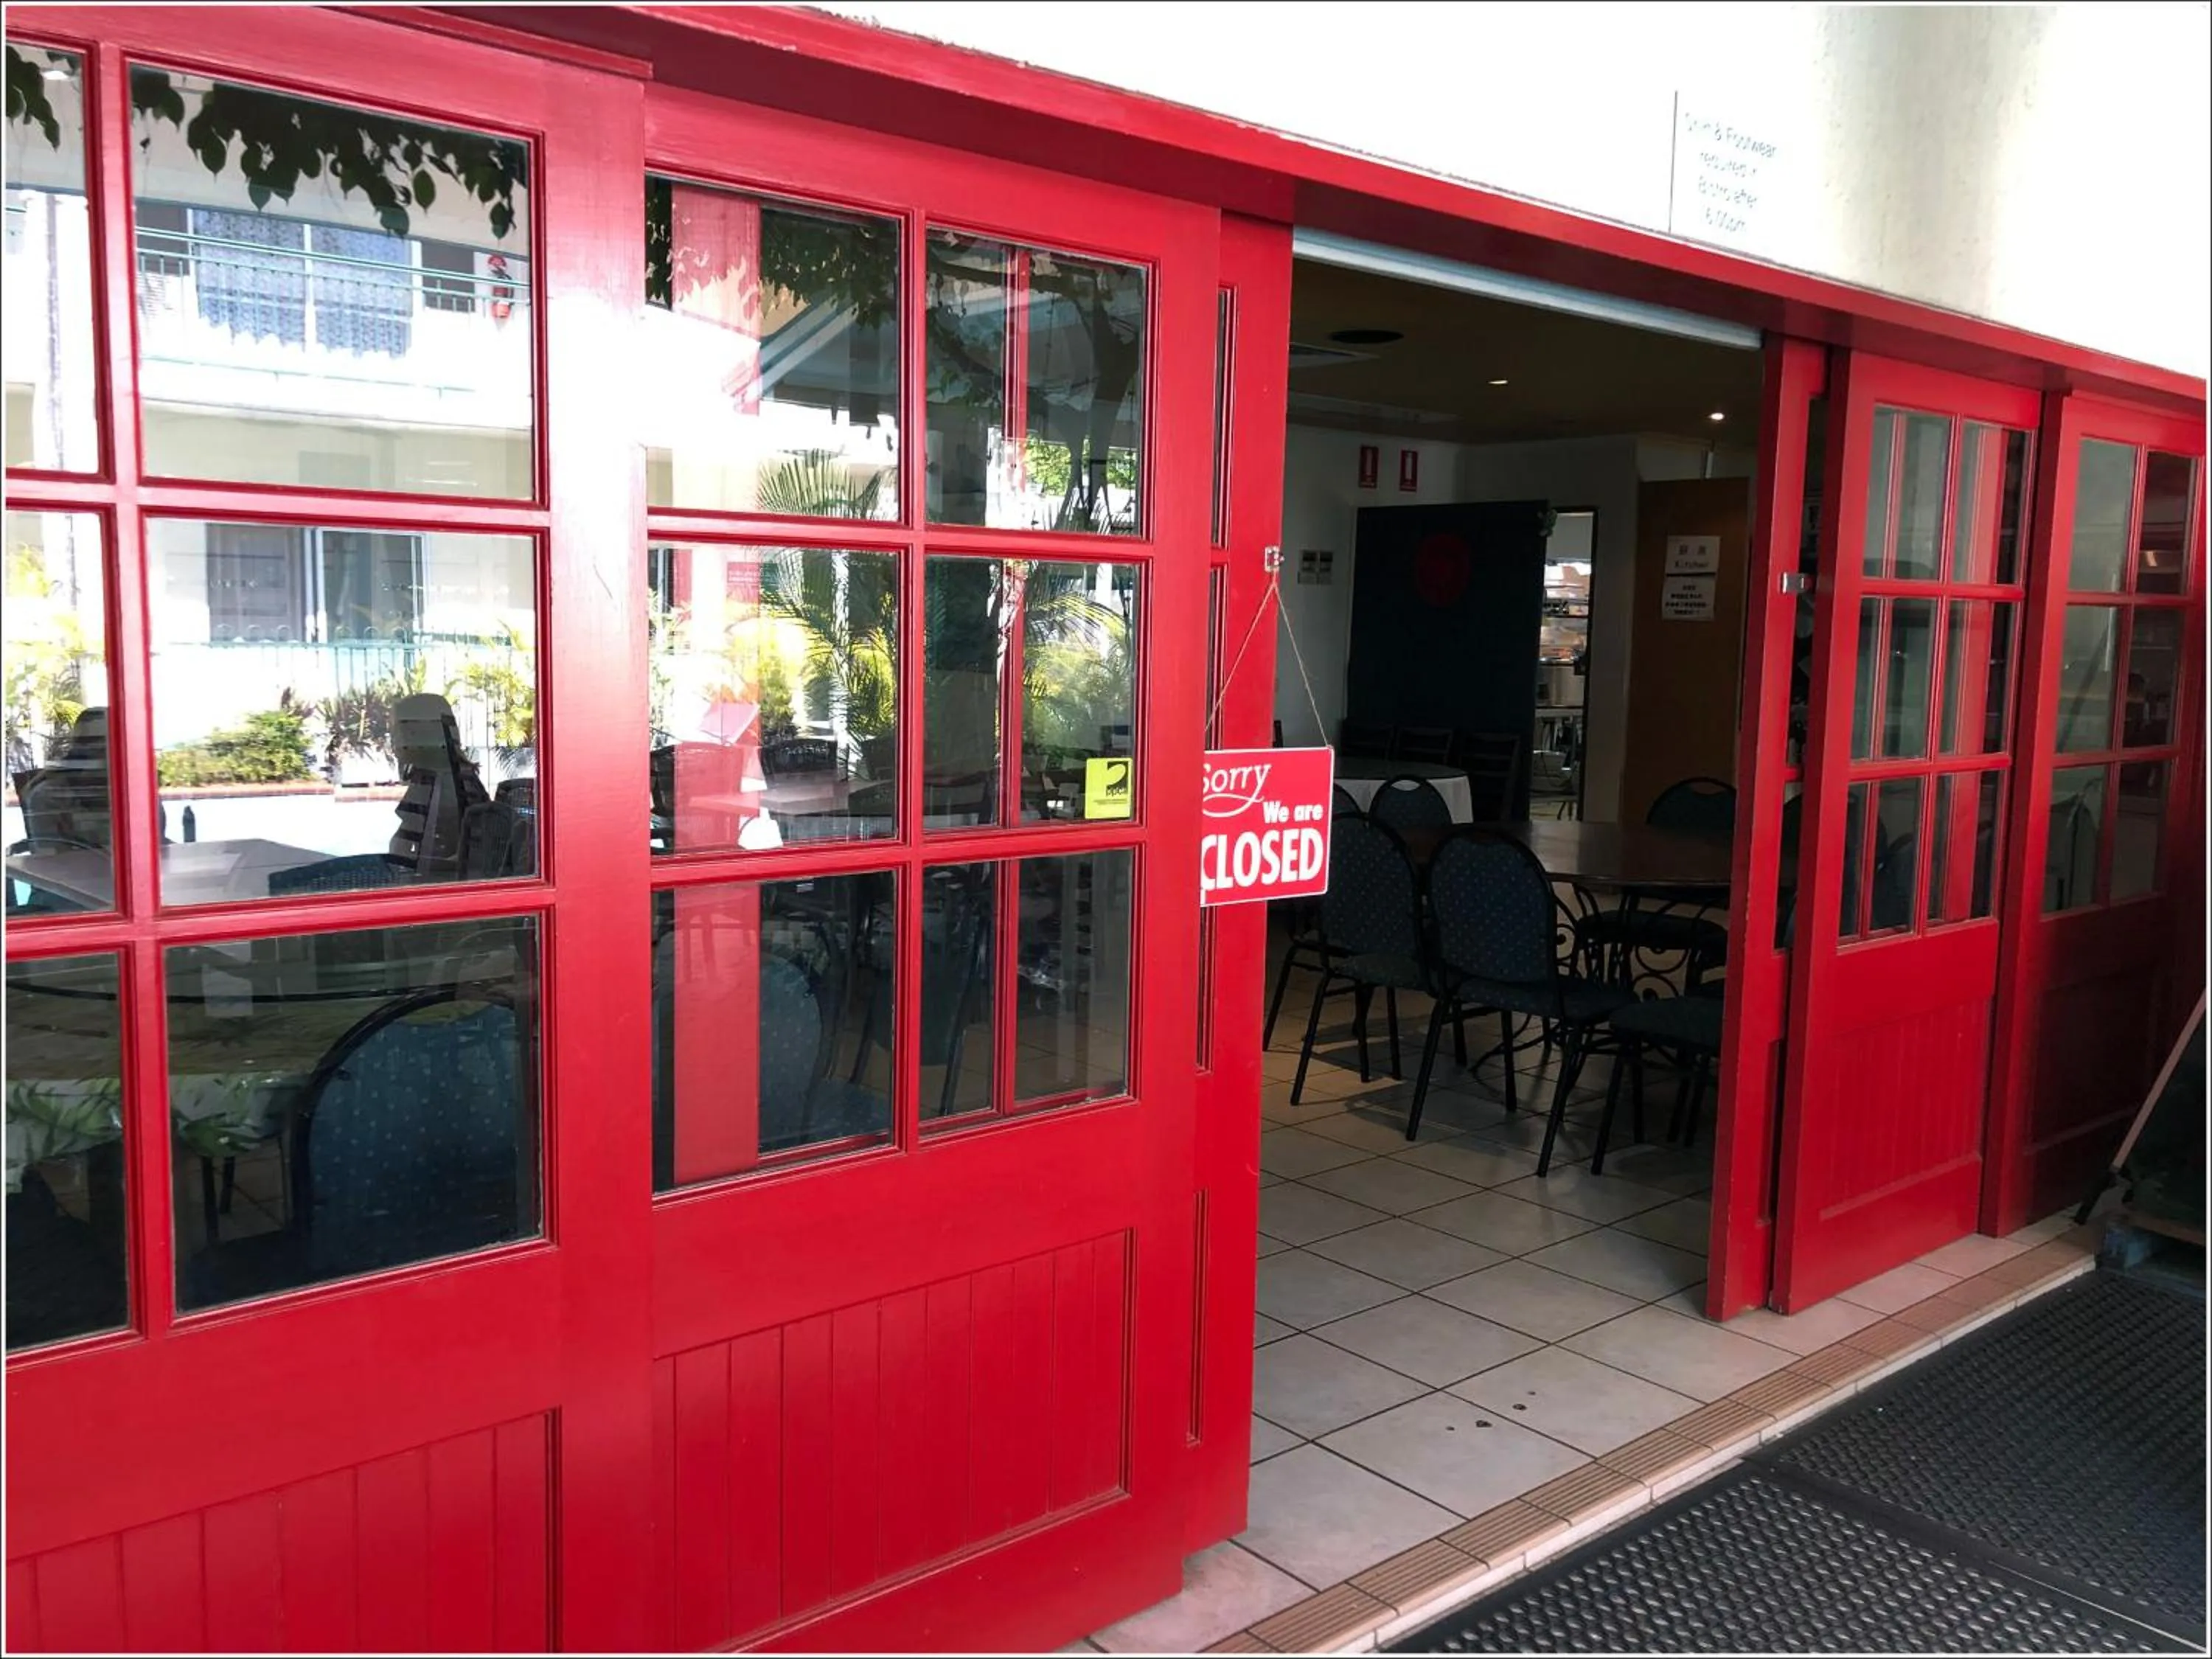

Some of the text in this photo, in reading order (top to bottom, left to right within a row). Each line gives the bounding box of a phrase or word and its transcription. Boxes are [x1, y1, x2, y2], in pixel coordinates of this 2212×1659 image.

[1262, 801, 1324, 824] We are
[1201, 827, 1324, 891] CLOSED
